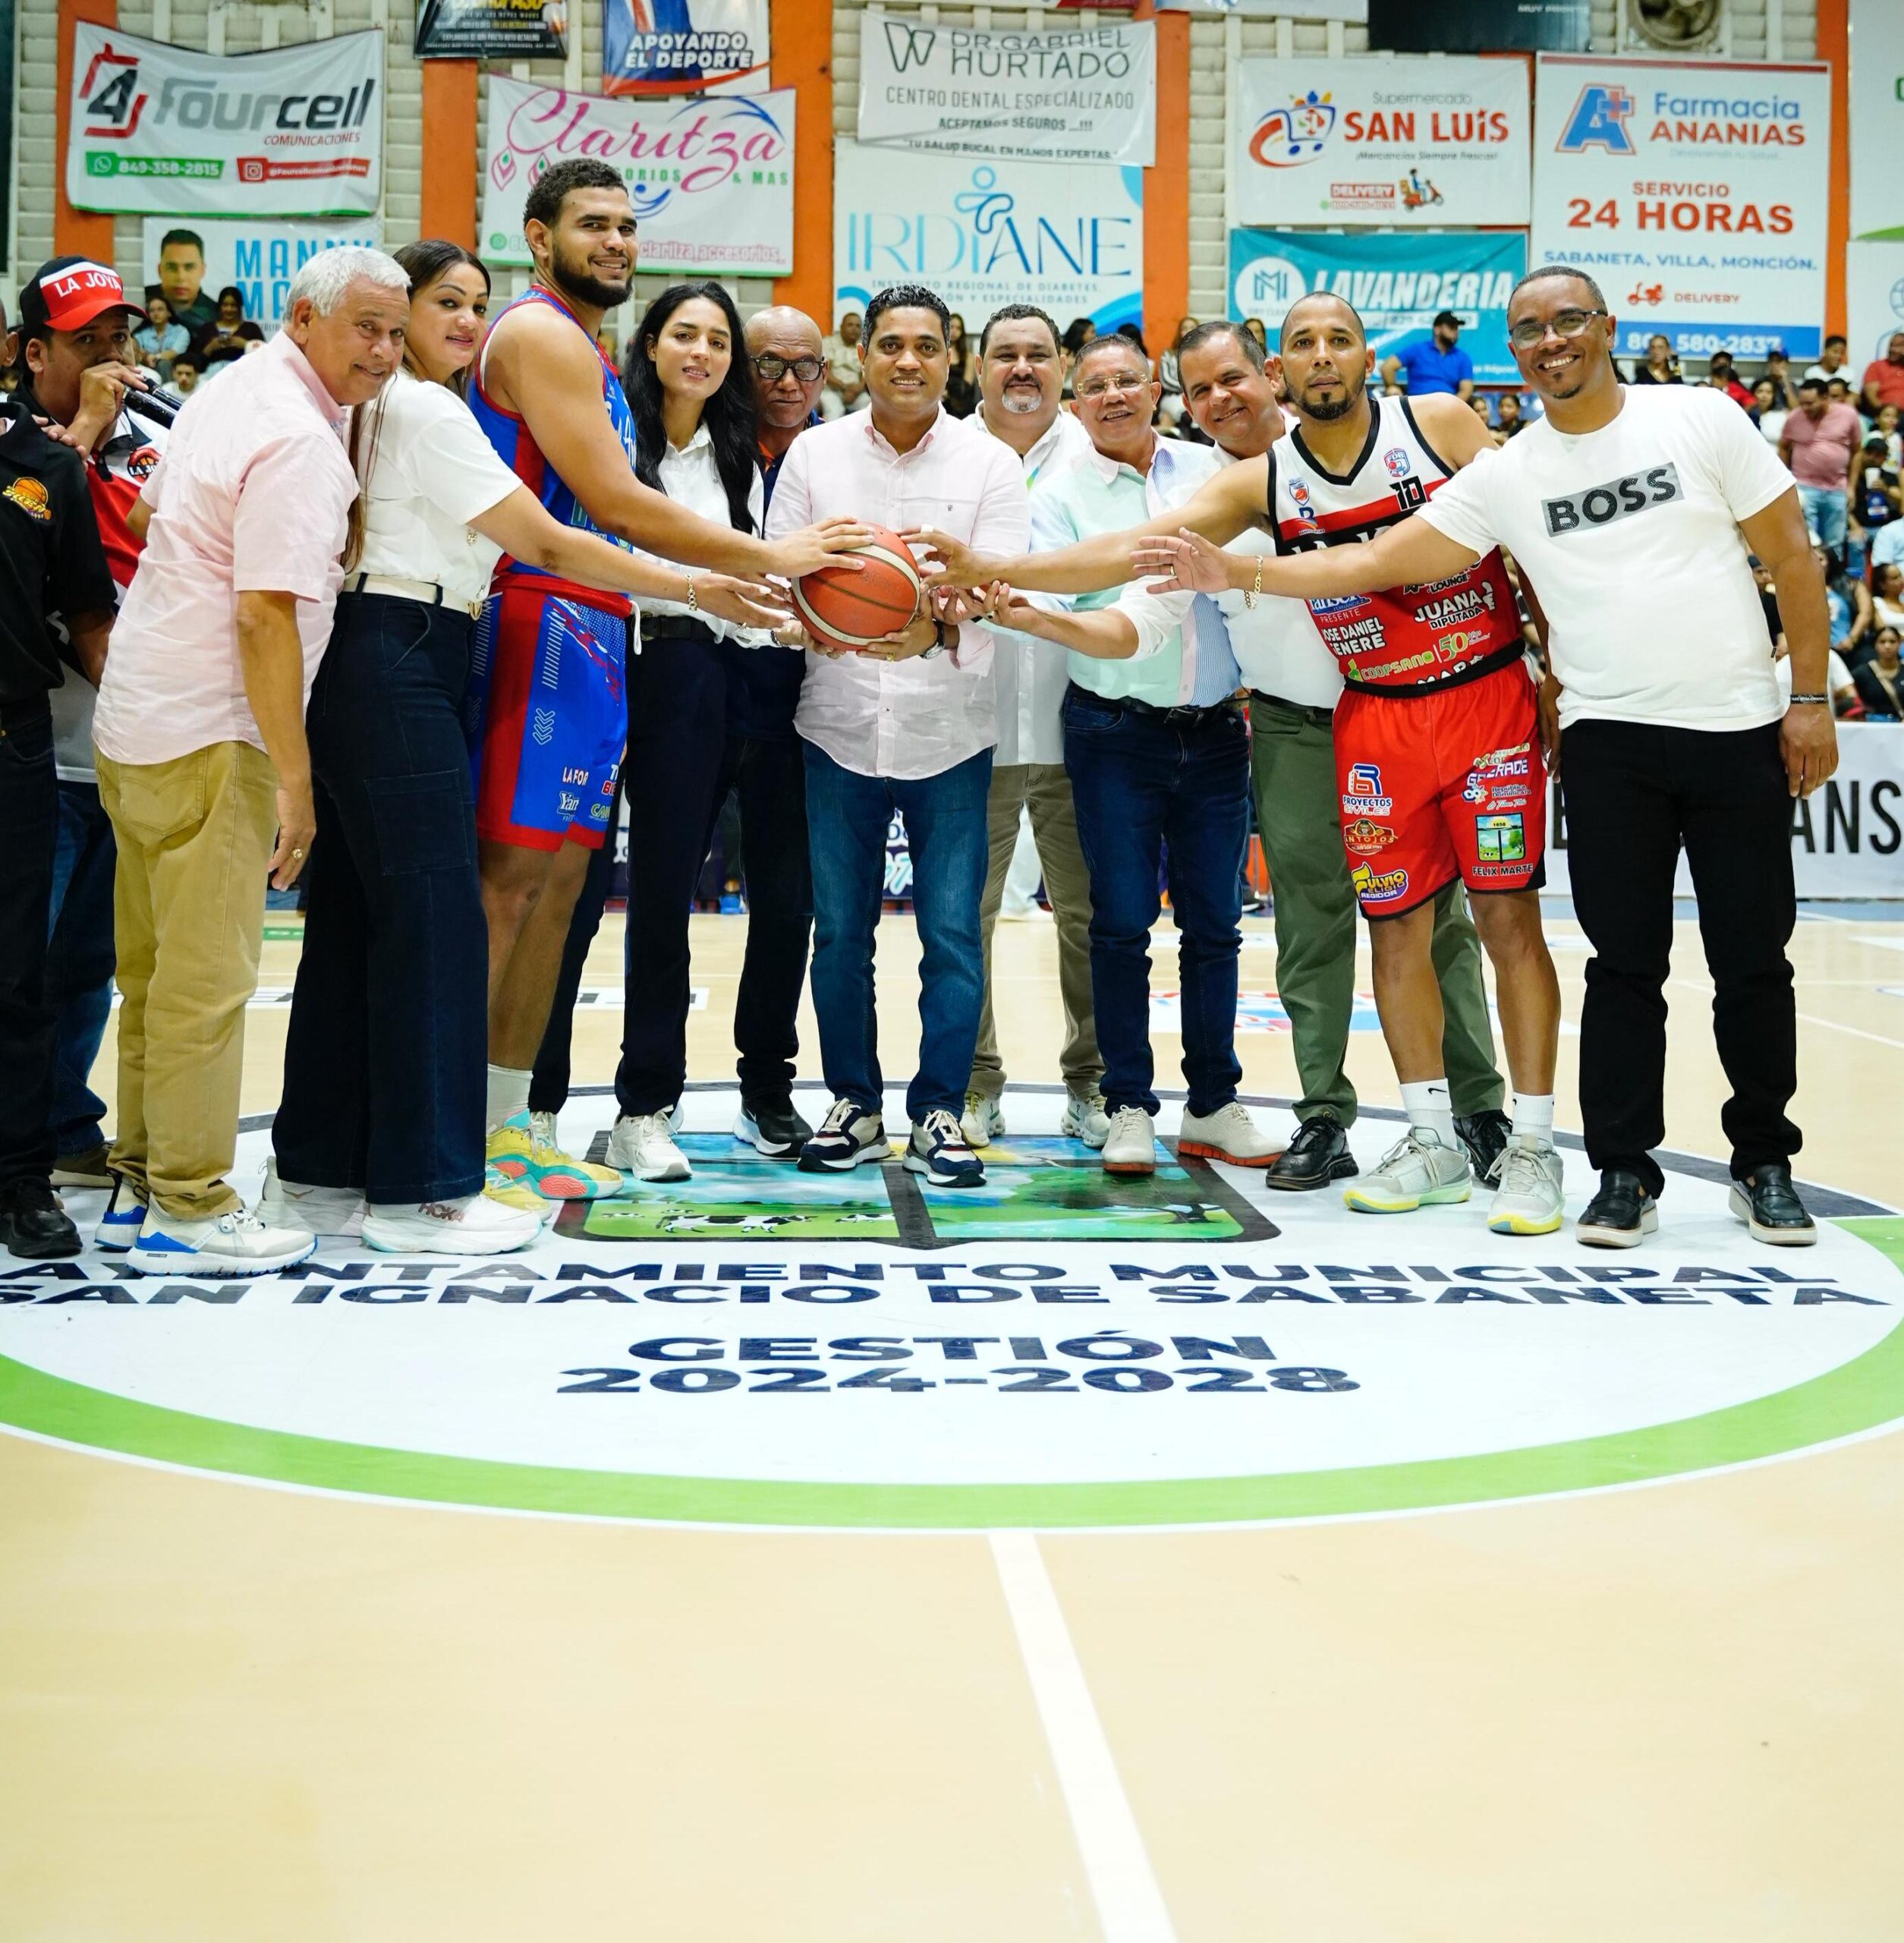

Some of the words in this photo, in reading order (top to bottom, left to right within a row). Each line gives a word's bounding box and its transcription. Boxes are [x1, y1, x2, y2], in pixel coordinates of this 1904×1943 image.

[629, 31, 747, 52] APOYANDO
[625, 51, 652, 69] EL
[656, 49, 754, 70] DEPORTE
[951, 49, 1131, 79] HURTADO
[153, 77, 376, 131] Fourcell
[886, 87, 946, 108] CENTRO
[951, 89, 1009, 110] DENTAL
[1015, 90, 1135, 111] ESPECIALIZADO
[1372, 92, 1472, 105] Supermercado
[1654, 92, 1800, 120] Farmacia
[1011, 118, 1066, 132] SEGUROS
[1343, 111, 1415, 143] SAN
[1649, 121, 1807, 147] ANANIAS
[263, 131, 361, 147] COMUNICACIONES
[506, 89, 786, 193] Claritza
[962, 143, 996, 154] BUCAL
[1000, 146, 1014, 156] EN
[1016, 146, 1054, 158] MANOS
[118, 159, 219, 178] 849-358-2815
[752, 172, 789, 187] MAS
[1632, 181, 1730, 197] SERVICIO
[1567, 198, 1619, 229] 24
[1636, 200, 1794, 235] HORAS
[1544, 250, 1651, 268] SABANETA,
[1657, 254, 1716, 269] VILLA,
[1720, 253, 1817, 272] MONCIÓN.
[55, 278, 80, 298] LA
[85, 274, 122, 294] JOYA
[948, 281, 1010, 291] REGIONAL
[1016, 282, 1032, 291] DE
[982, 294, 1089, 304] ESPECIALIDADES
[1674, 291, 1740, 304] DELIVERY
[130, 465, 143, 477] LA
[1389, 475, 1427, 512] 10
[1547, 467, 1677, 534] BOSS
[1320, 608, 1361, 624] PRESENTE
[1414, 589, 1484, 622] JUANA
[1430, 606, 1484, 630] DIPUTADA
[1321, 627, 1342, 642] OSE
[1339, 616, 1384, 640] DANIEL
[1330, 632, 1386, 656] ENERE
[1439, 631, 1469, 662] 50
[1361, 650, 1435, 680] COOPSANO
[1342, 796, 1393, 808] PROYECTOS
[1343, 805, 1391, 816] CIVILES
[1472, 867, 1498, 877] FELIX
[1500, 863, 1534, 876] MARTE
[1361, 890, 1398, 899] REGIDOR
[417, 1202, 466, 1223] HOKA
[0, 1263, 1067, 1281] AYNTAMIENTO
[1109, 1264, 1839, 1283] MUNICIPAL
[292, 1285, 881, 1304] IGNACIO
[927, 1285, 1111, 1304] DE
[1148, 1286, 1894, 1306] SABANETA
[628, 1329, 1277, 1362] GESTIÓN
[556, 1367, 1361, 1394] 2024-2028
